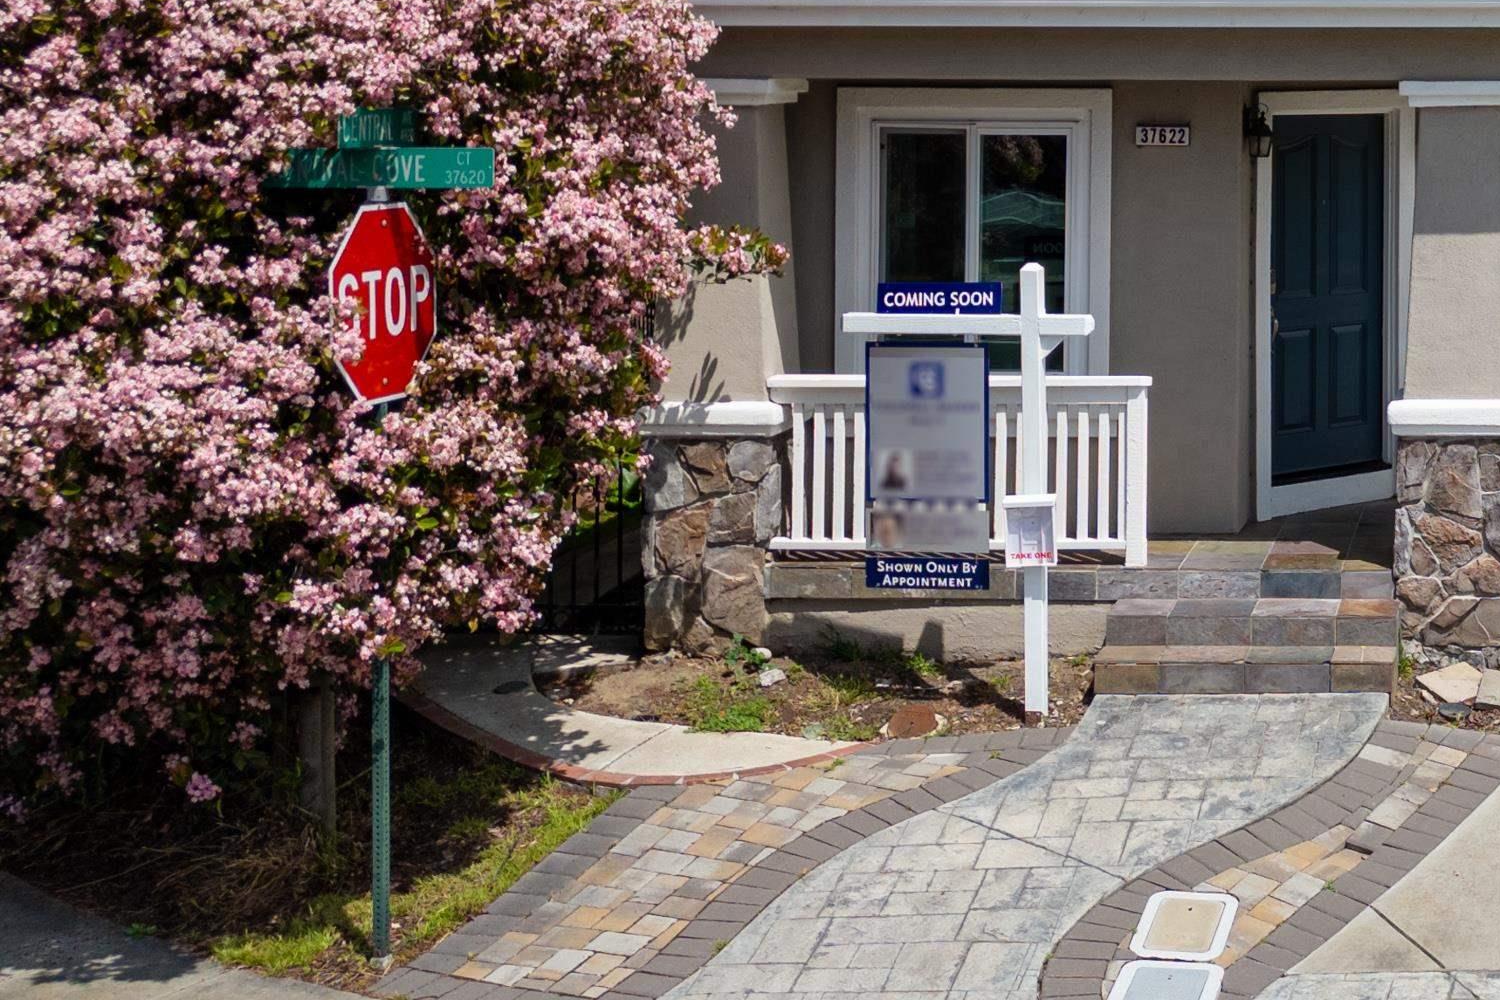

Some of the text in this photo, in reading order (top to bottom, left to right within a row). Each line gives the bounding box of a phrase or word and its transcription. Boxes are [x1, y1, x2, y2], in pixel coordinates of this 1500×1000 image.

[1141, 128, 1185, 144] 37622
[372, 154, 425, 183] COVE
[456, 151, 472, 166] CT
[445, 170, 486, 185] 37620
[338, 264, 430, 340] STOP
[884, 291, 994, 307] COMING SOON
[1010, 551, 1053, 559] TAKE ONE
[882, 574, 973, 588] APPOINTMENT
